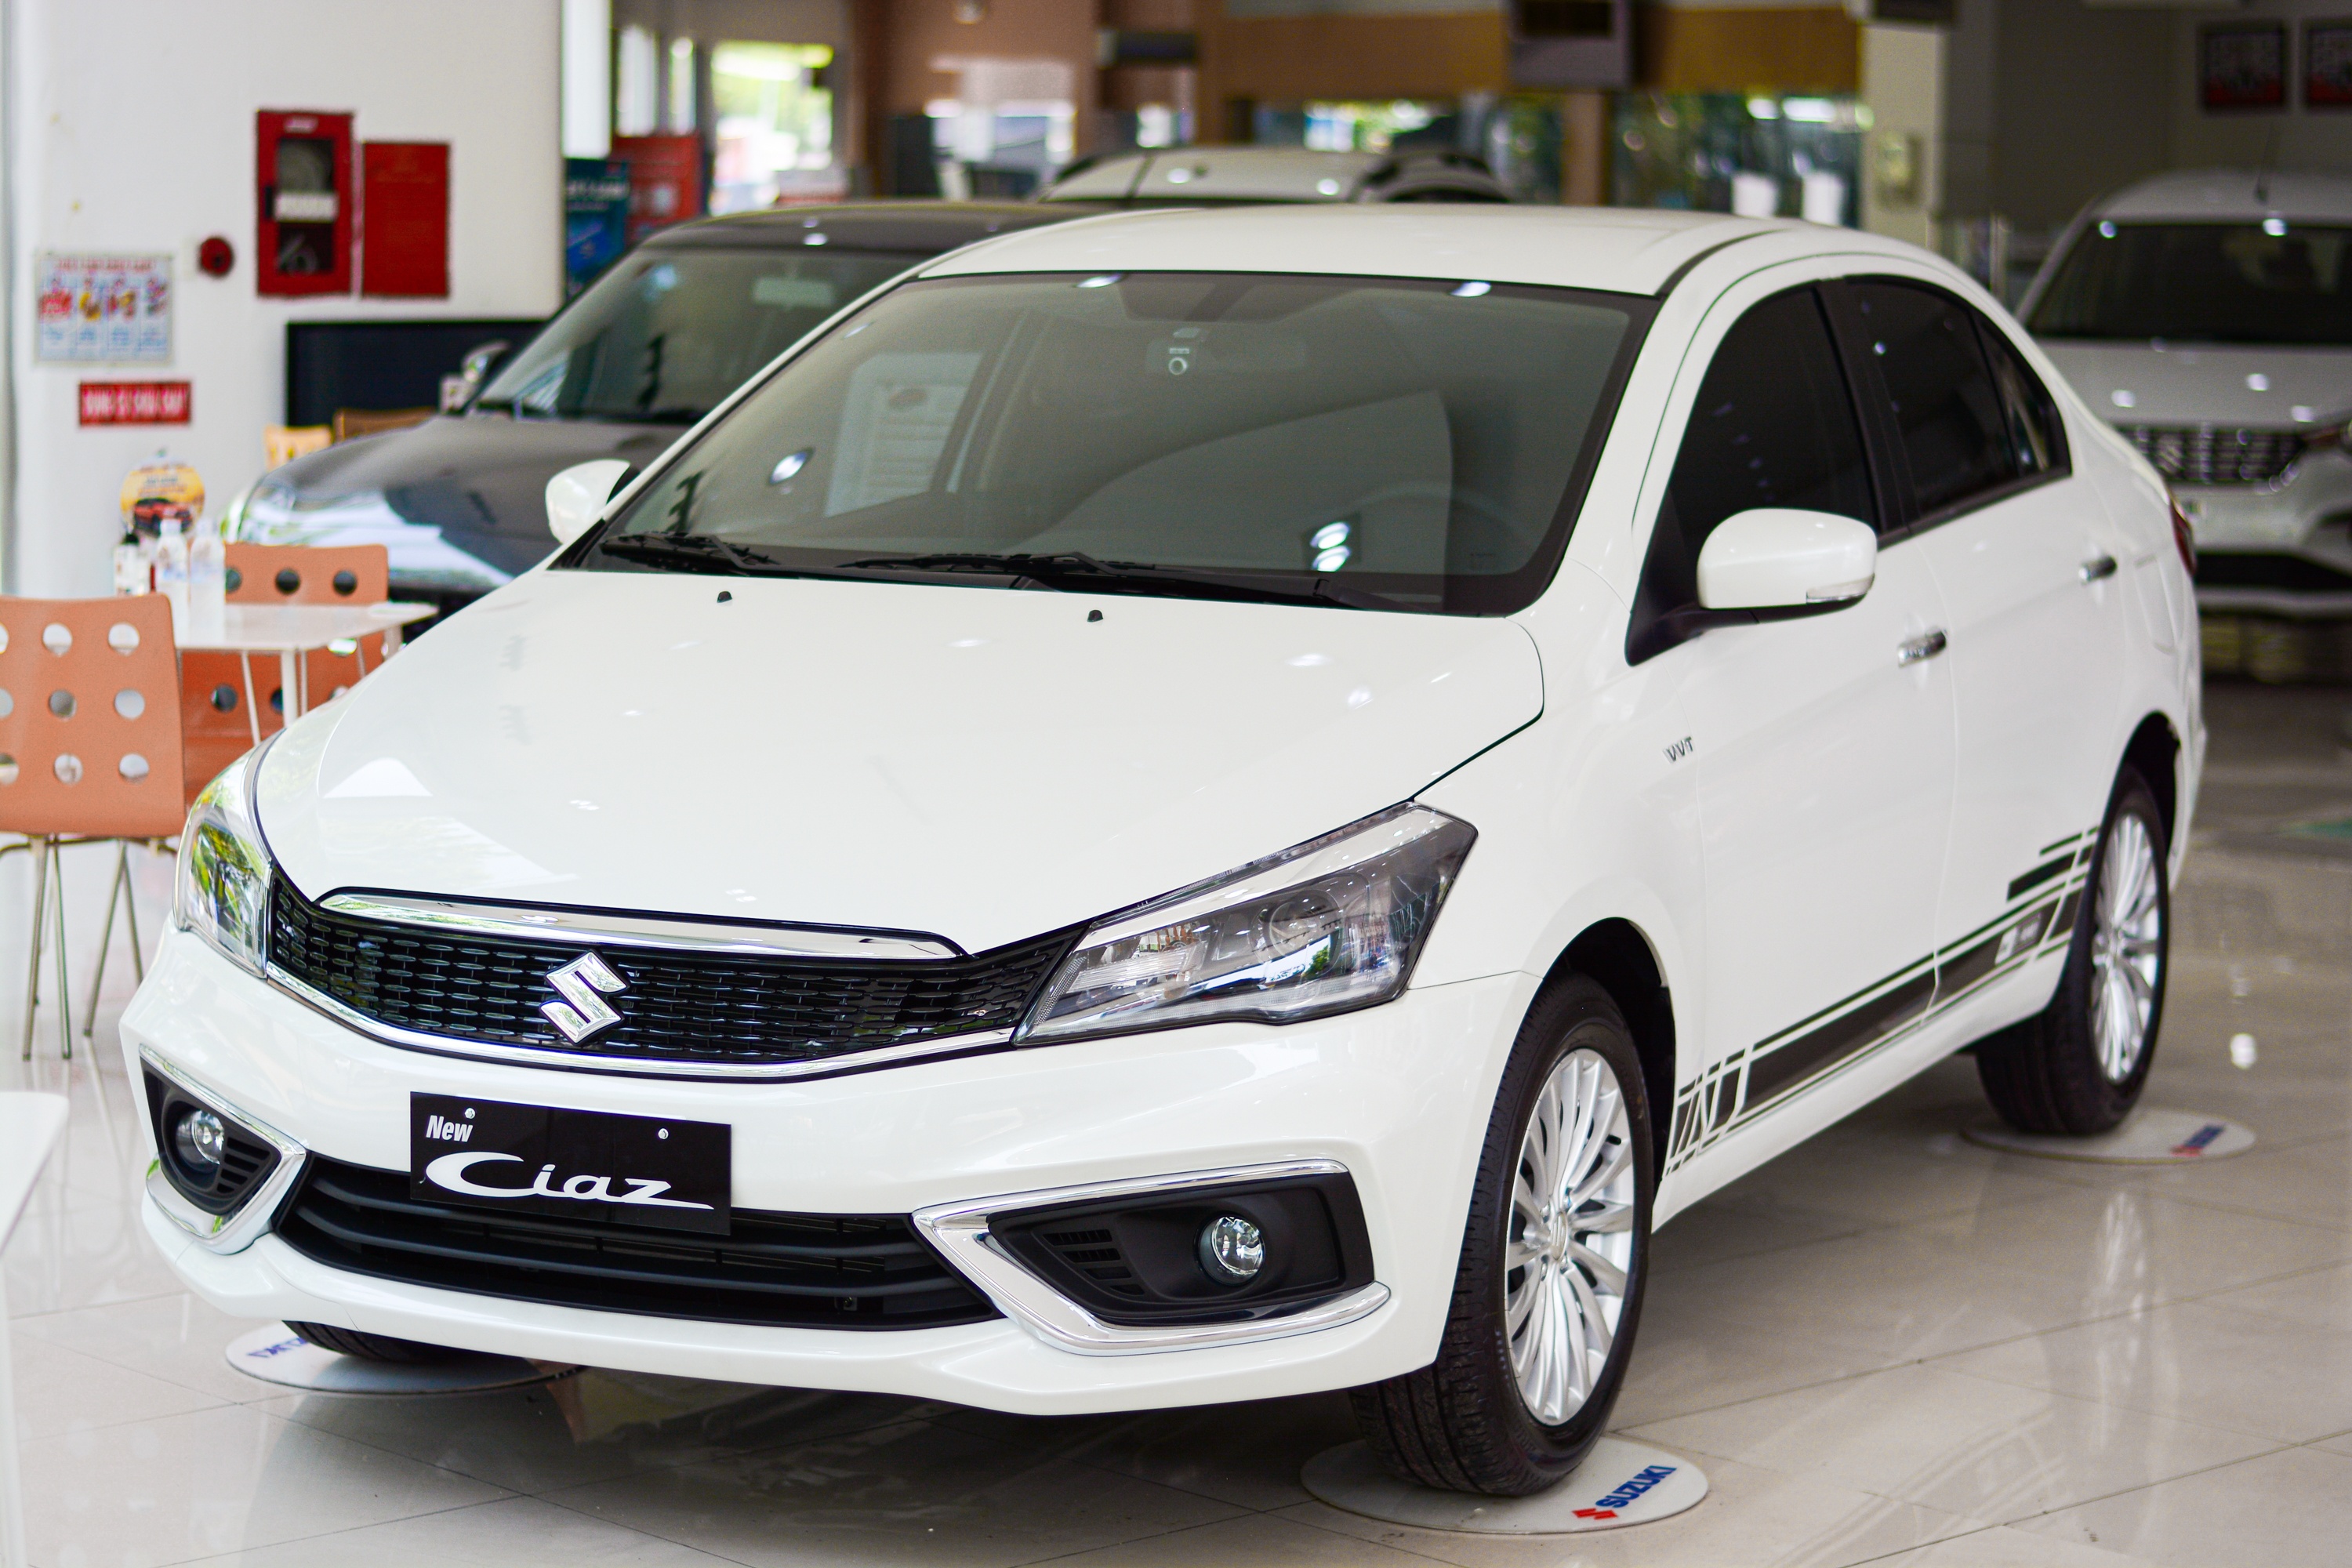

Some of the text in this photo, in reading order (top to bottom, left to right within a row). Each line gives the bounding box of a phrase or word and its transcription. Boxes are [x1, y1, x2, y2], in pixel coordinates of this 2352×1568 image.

[1663, 736, 1693, 763] VVT
[426, 1114, 474, 1142] New
[426, 1151, 714, 1210] Ciaz
[1595, 1465, 1678, 1508] SUZUKI
